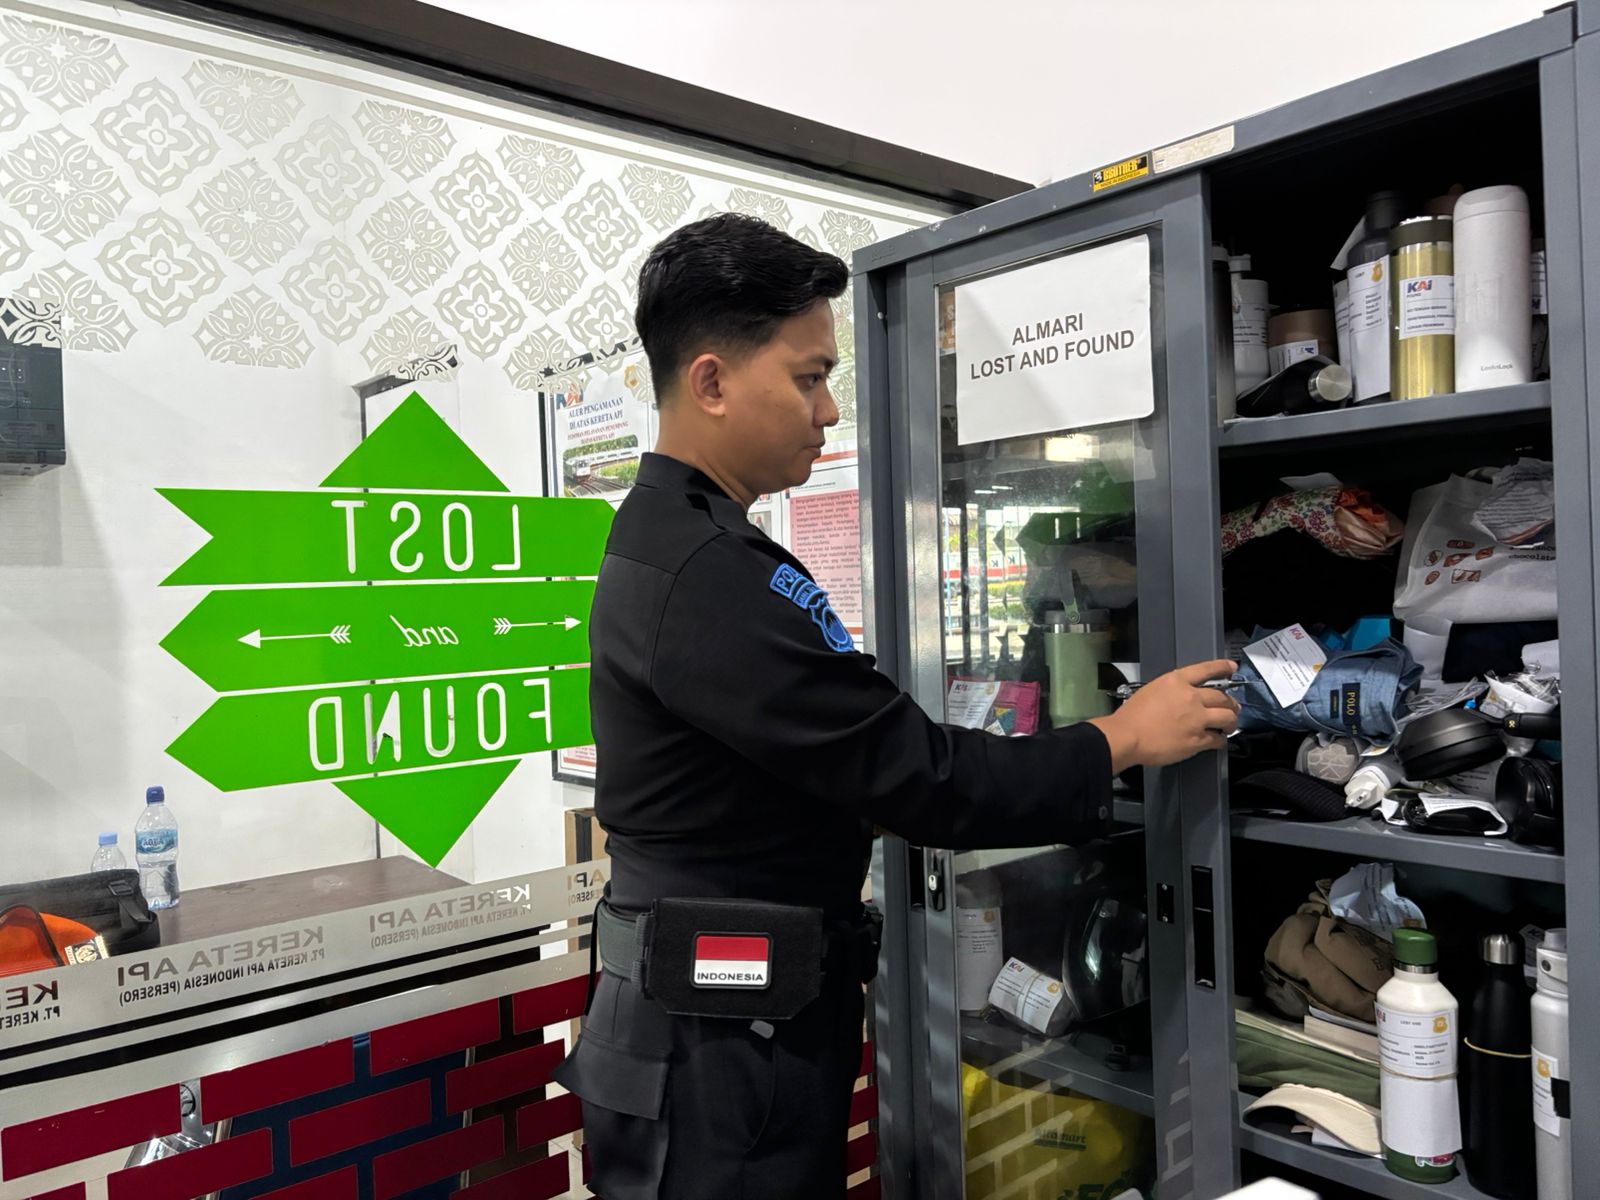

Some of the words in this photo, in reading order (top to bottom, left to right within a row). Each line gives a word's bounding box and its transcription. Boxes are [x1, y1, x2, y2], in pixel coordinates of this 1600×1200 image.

[1407, 280, 1432, 294] KAI
[1012, 313, 1083, 346] ALMARI
[971, 355, 1015, 380] LOST
[1020, 346, 1058, 370] AND
[1065, 330, 1134, 360] FOUND
[1347, 692, 1355, 716] POLO
[697, 972, 764, 981] INDONESIA
